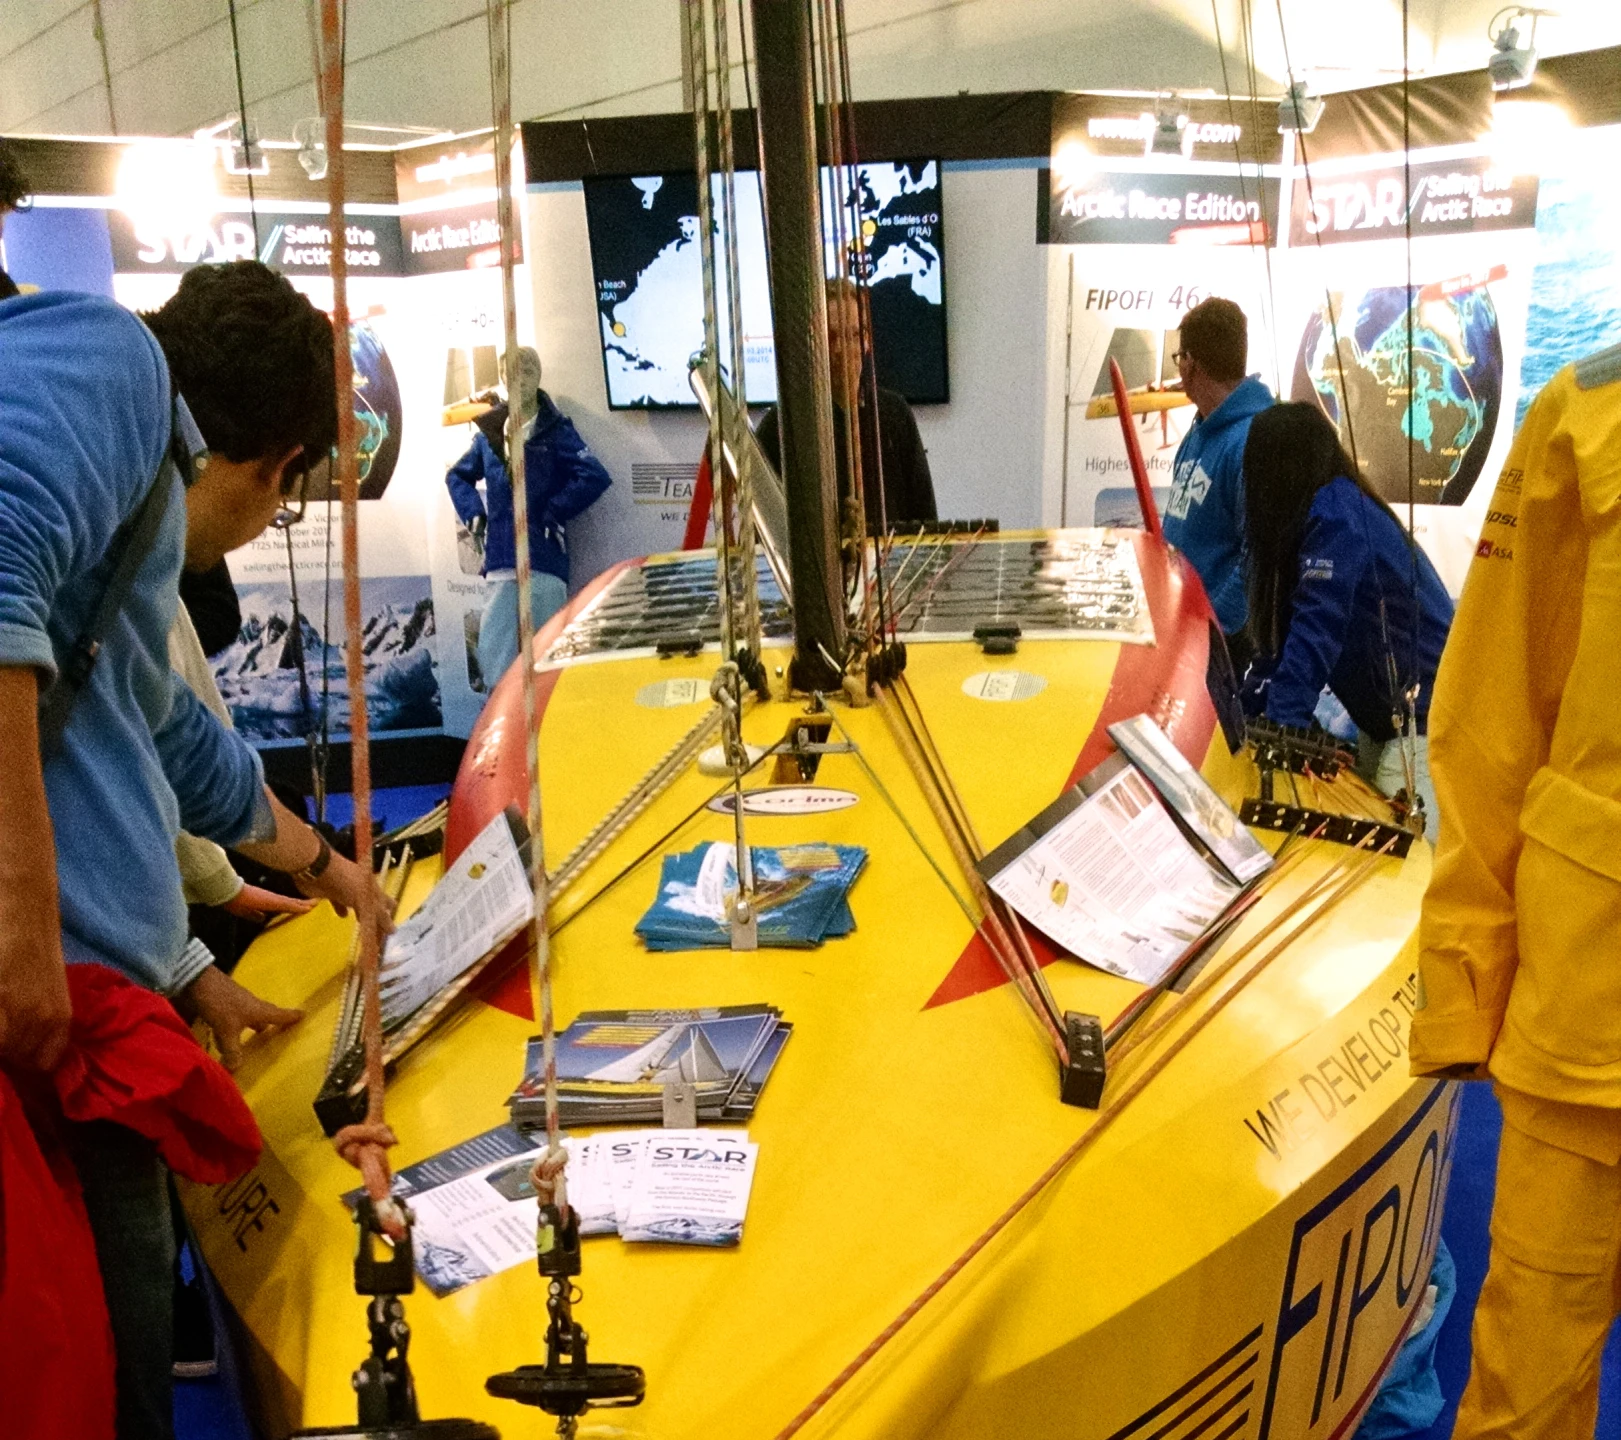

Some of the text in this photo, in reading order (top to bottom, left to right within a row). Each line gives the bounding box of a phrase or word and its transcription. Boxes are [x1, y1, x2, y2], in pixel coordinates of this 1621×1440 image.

[1060, 188, 1260, 222] Arctic Race Edition
[1306, 178, 1404, 234] STAR
[1427, 173, 1480, 198] Sailing
[1421, 195, 1513, 222] Arctic Race
[877, 217, 892, 226] Les
[907, 226, 932, 237] (FRA)
[283, 225, 333, 246] Sailin
[345, 225, 376, 246] the
[1085, 455, 1175, 475] Highes aftey
[664, 477, 693, 498] TEA
[311, 539, 335, 549] Mils
[1298, 1008, 1408, 1123] DEVELOP
[653, 1147, 748, 1165] STAR
